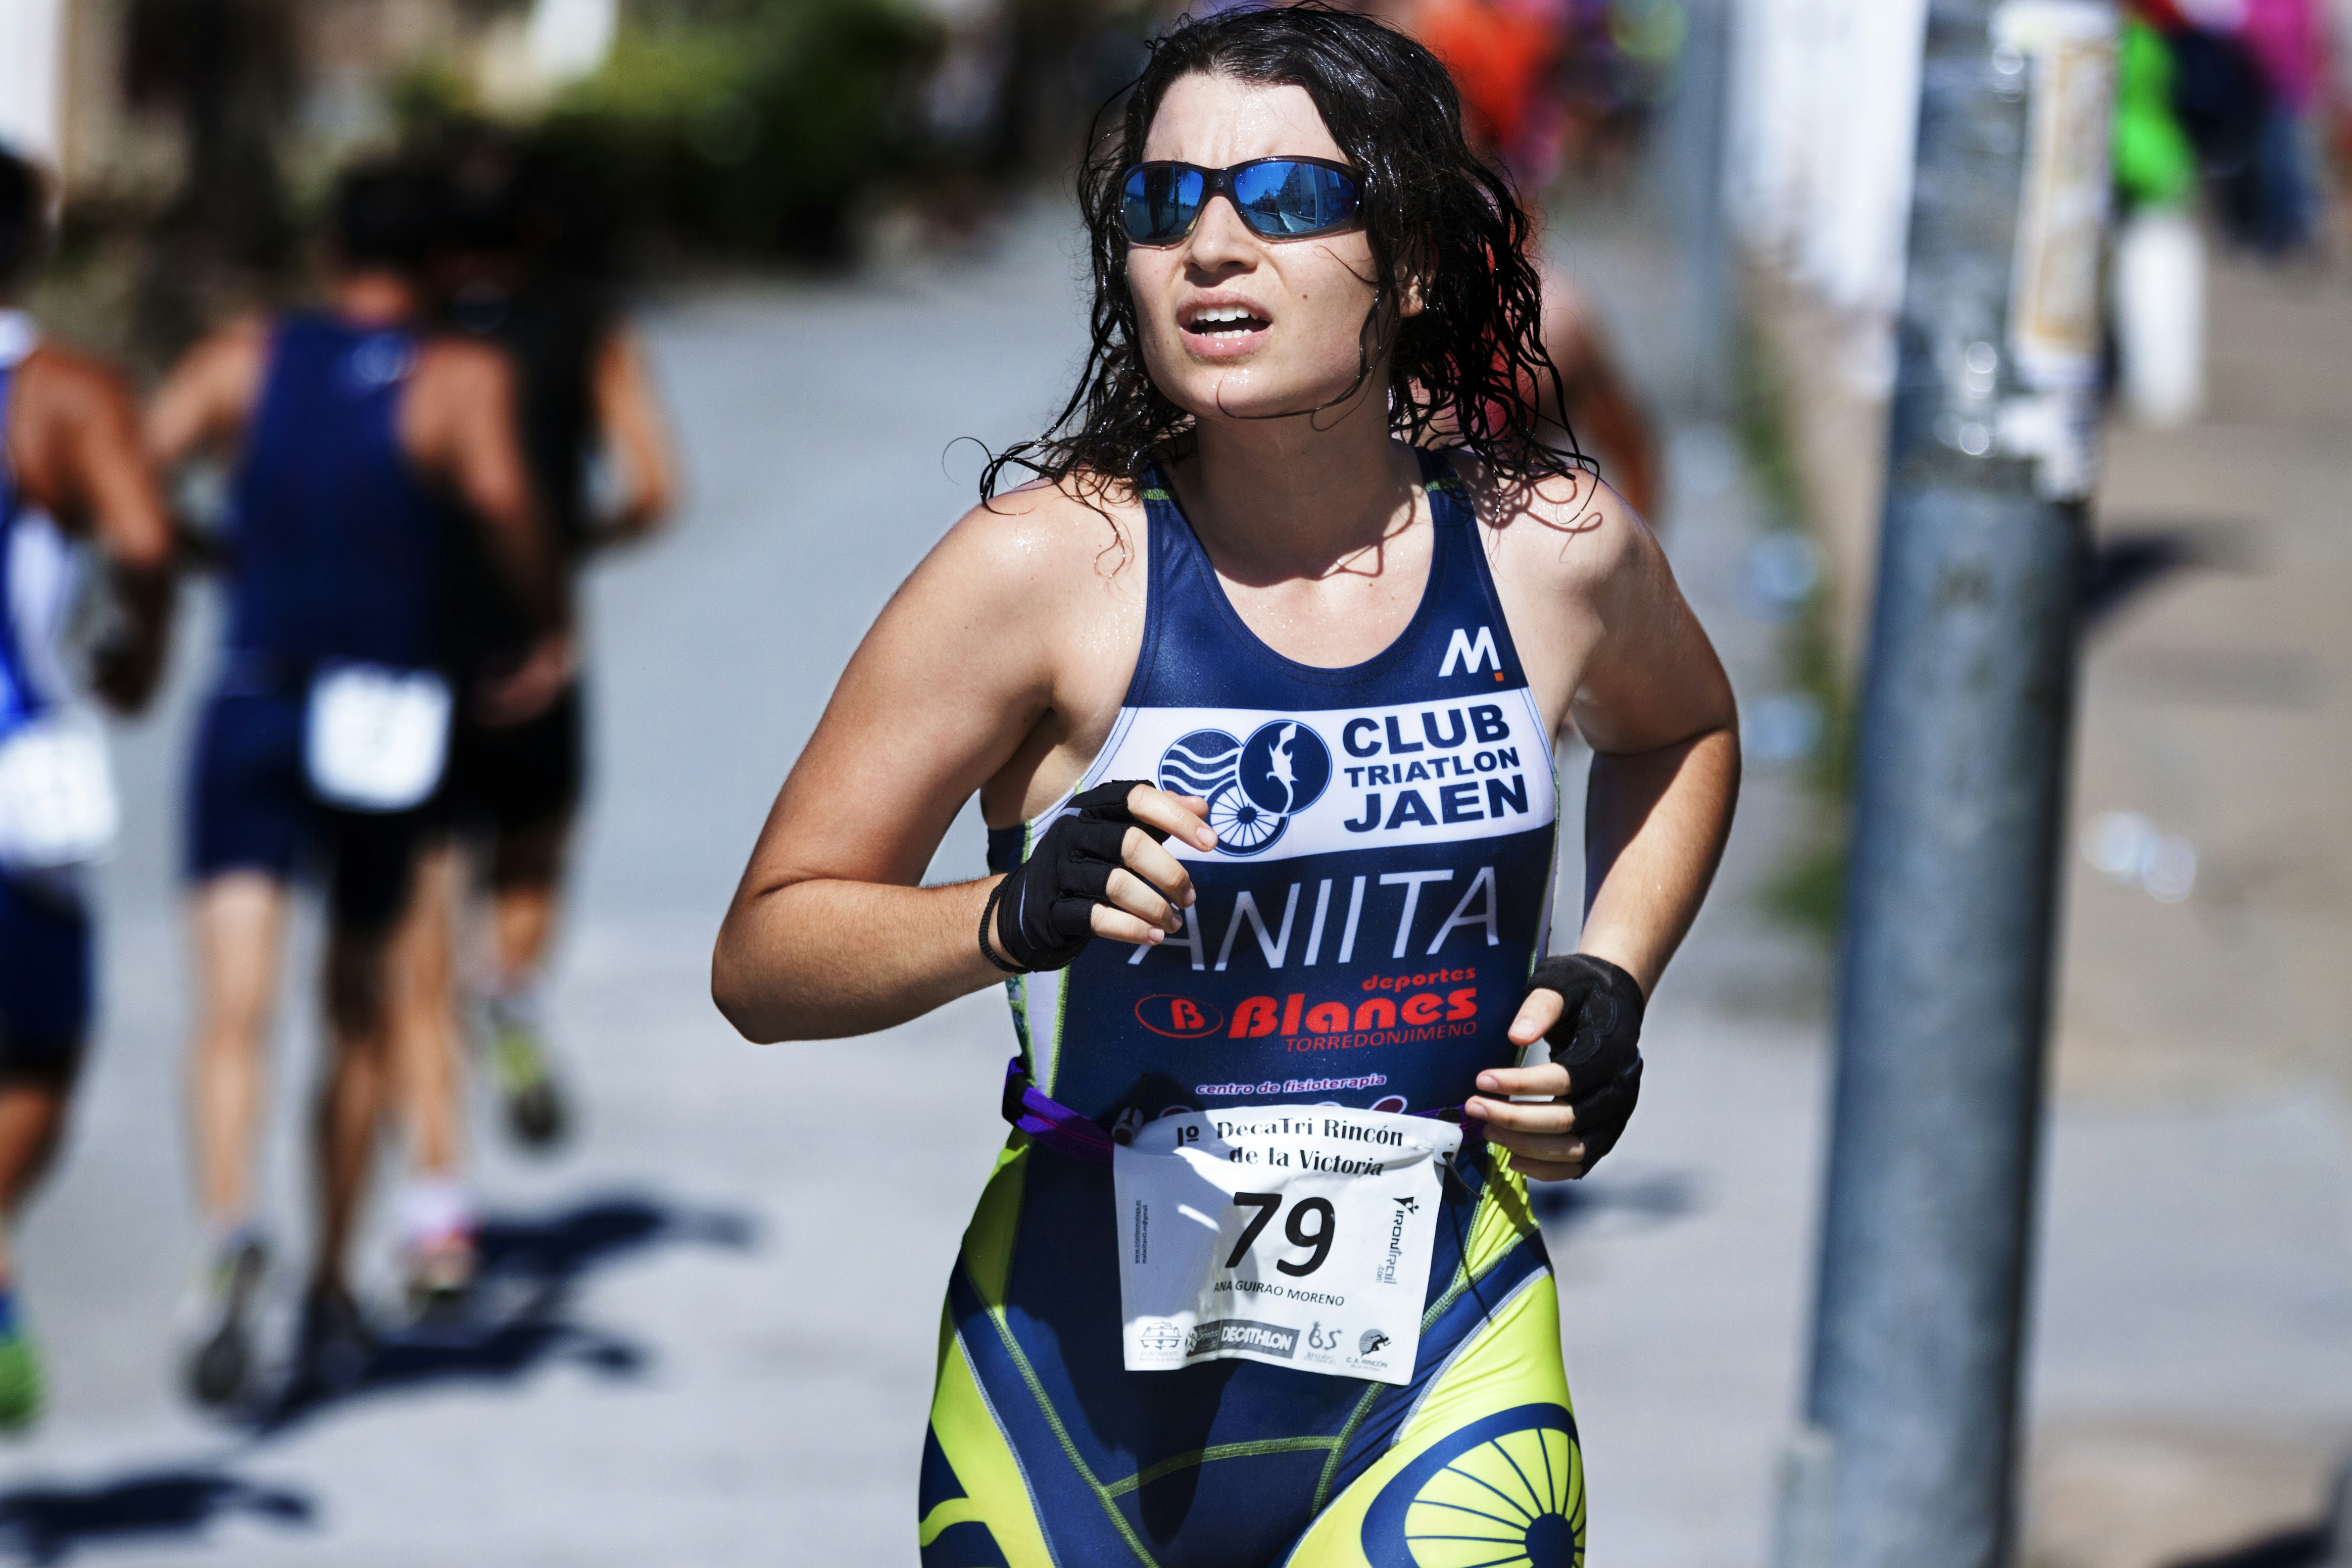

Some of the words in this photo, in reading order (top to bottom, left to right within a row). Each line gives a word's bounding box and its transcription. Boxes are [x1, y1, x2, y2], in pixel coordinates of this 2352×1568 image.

[1342, 704, 1510, 758] CLUB
[1344, 747, 1520, 788] TRIATLON
[1344, 774, 1529, 832] JAEN
[1127, 866, 1499, 971] ANIITA
[1362, 968, 1476, 992] deportes
[1171, 999, 1205, 1029] B
[1228, 988, 1477, 1038] Blanes
[1286, 1021, 1476, 1052] TORREDONJIMENO
[1196, 1083, 1254, 1095] centro
[1258, 1081, 1279, 1094] de
[1283, 1074, 1386, 1093] fisioterapia
[1218, 1118, 1313, 1138] DecaTri
[1324, 1119, 1403, 1146] Rincón
[1230, 1147, 1258, 1165] de
[1269, 1147, 1290, 1167] la
[1300, 1149, 1384, 1176] Victoria
[1225, 1192, 1336, 1277] 79
[1214, 1281, 1232, 1293] ANA
[1235, 1281, 1283, 1296] GUIRAO
[1287, 1289, 1345, 1306] MORENO
[1222, 1326, 1292, 1351] DECATHLON
